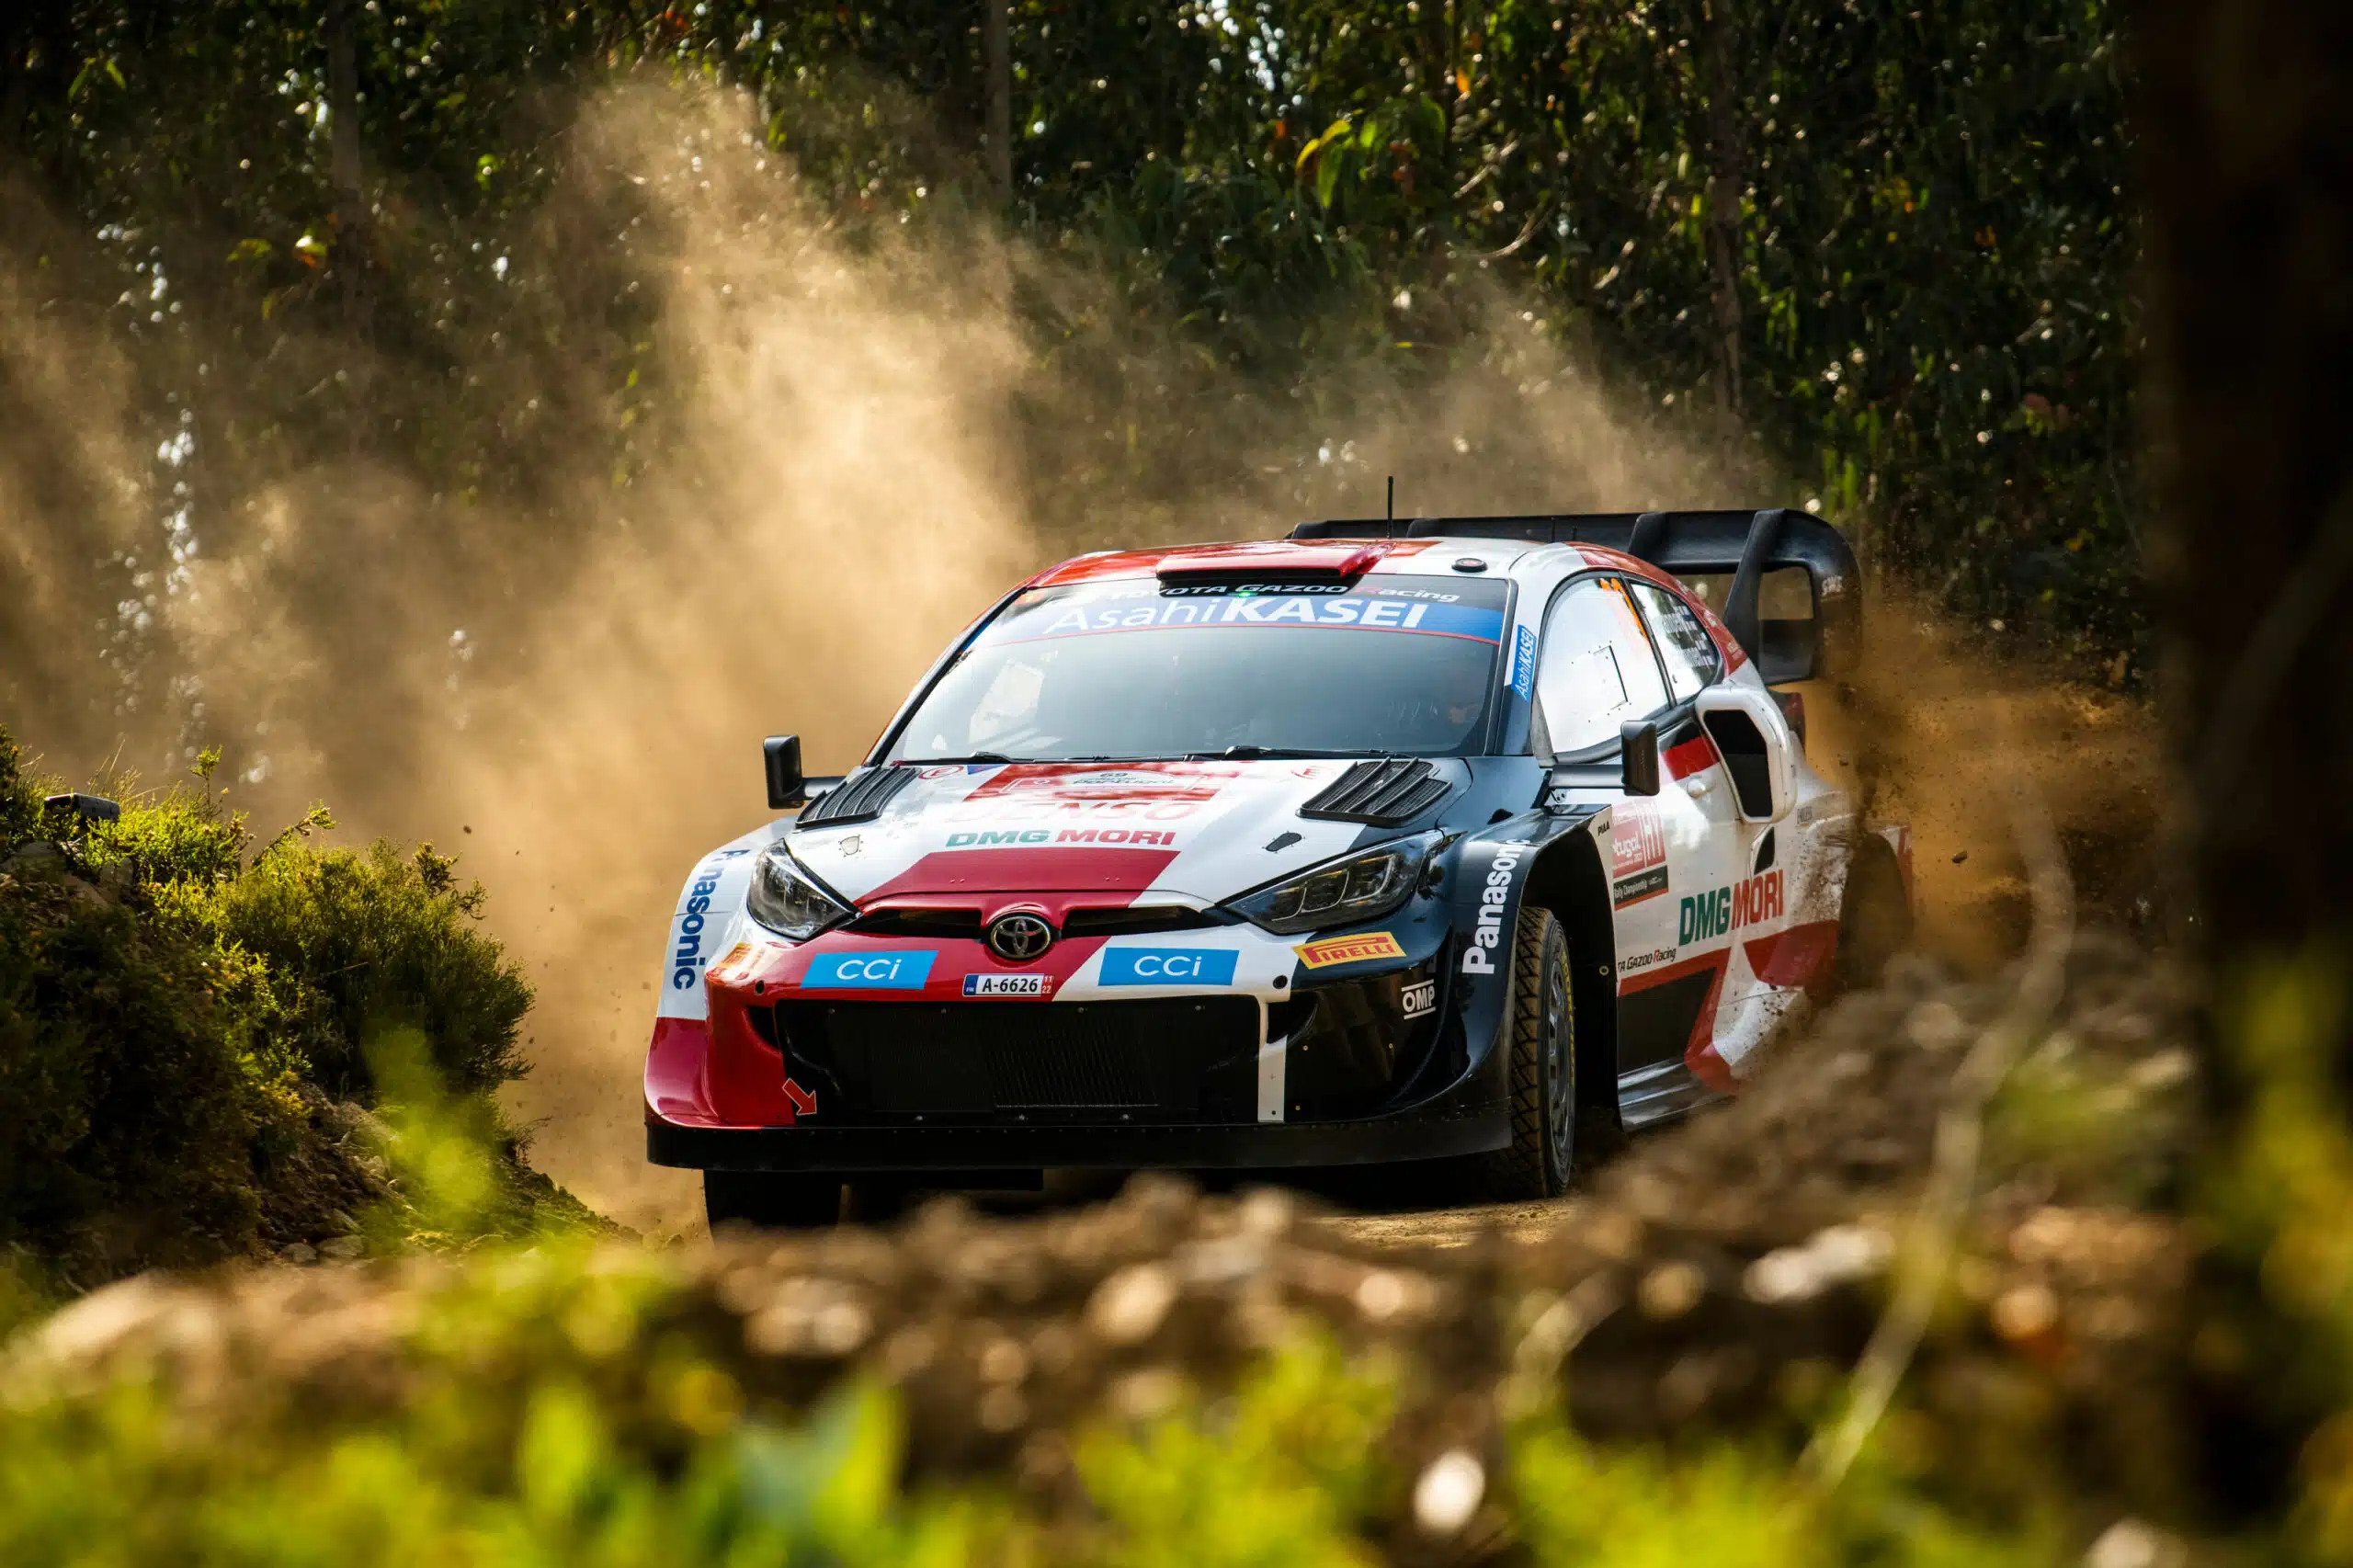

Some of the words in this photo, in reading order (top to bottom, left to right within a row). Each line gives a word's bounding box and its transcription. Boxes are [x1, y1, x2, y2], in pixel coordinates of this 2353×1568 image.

[1234, 584, 1349, 594] GAZOO
[1353, 586, 1461, 603] Racing
[1042, 597, 1430, 634] AsahiKASEI
[1515, 627, 1535, 699] AsahiKASEI
[945, 802, 1199, 822] ENSO
[946, 829, 1051, 847] DMG
[1055, 829, 1176, 846] MORI
[1678, 886, 1731, 946] DMG
[1731, 869, 1783, 930] MORI
[1303, 937, 1395, 963] PIRELLI
[1627, 953, 1653, 971] GAZOO
[1654, 947, 1677, 963] Racing
[835, 958, 902, 980] CCi
[1133, 954, 1203, 977] CCi
[982, 978, 1038, 993] A-6626
[1402, 984, 1436, 1012] OMP
